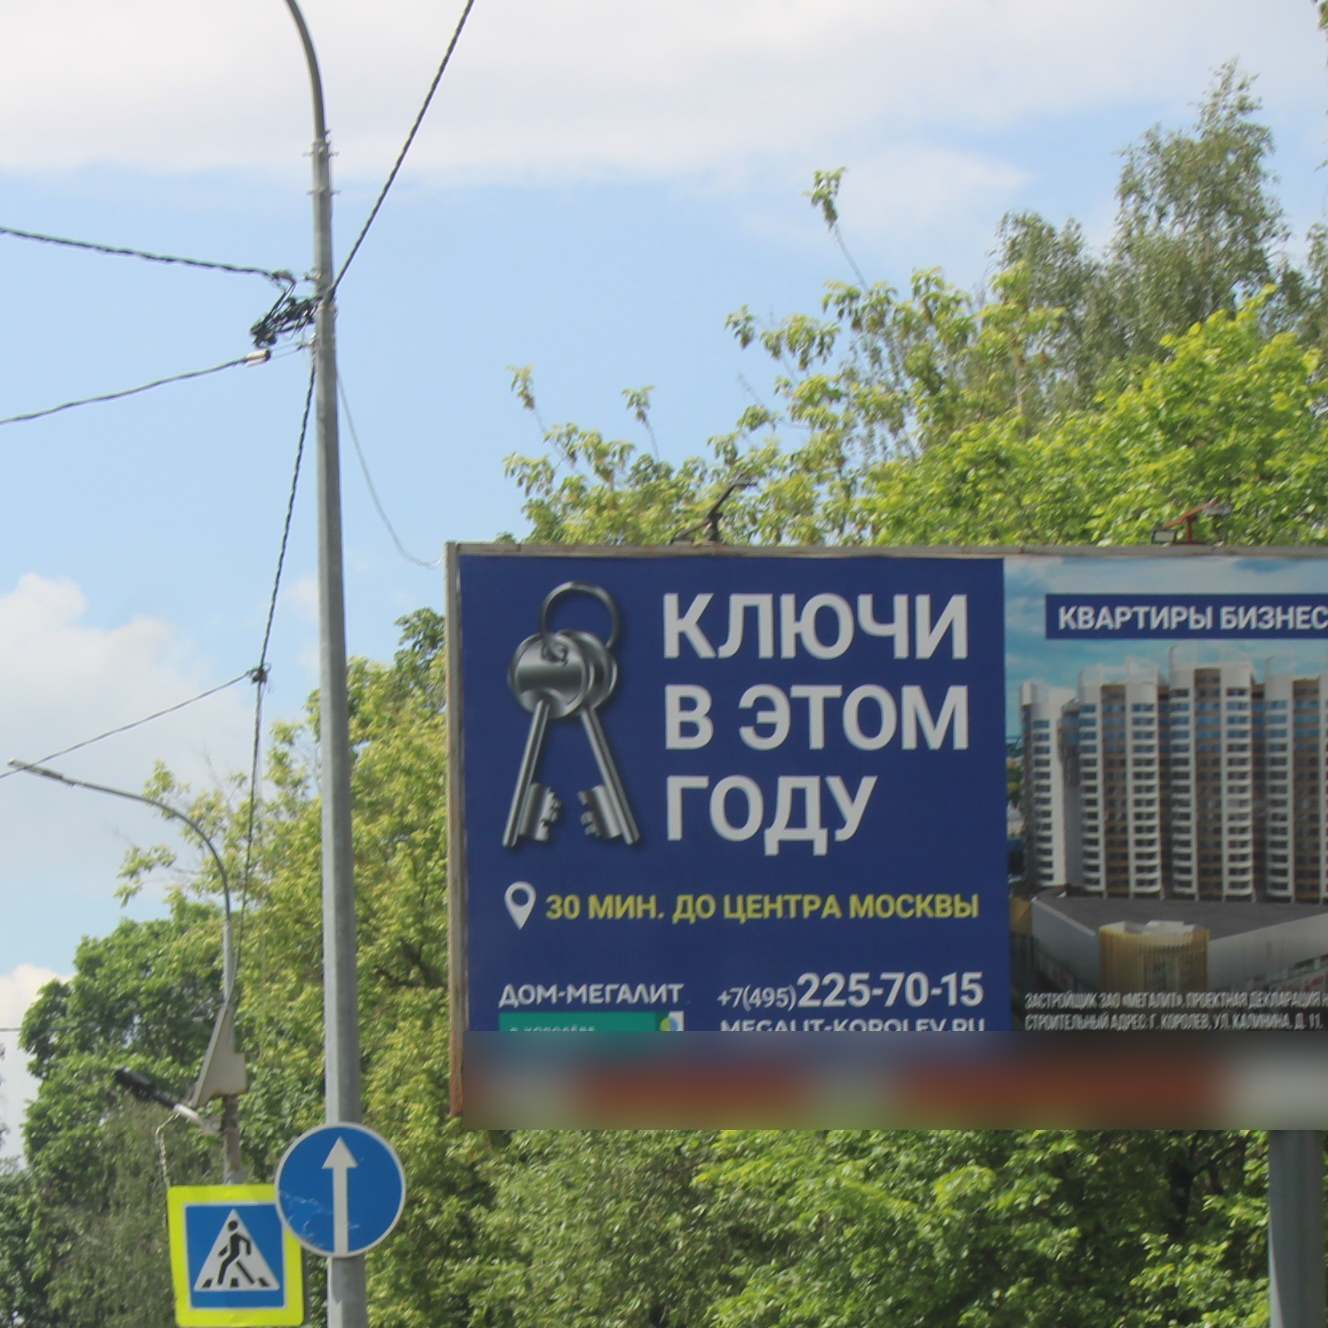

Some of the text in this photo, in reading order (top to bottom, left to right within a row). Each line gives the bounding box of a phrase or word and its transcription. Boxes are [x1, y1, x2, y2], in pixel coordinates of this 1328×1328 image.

[663, 592, 968, 660] КЛЮЧИ
[1058, 606, 1213, 631] КВАРТИРЫ
[664, 683, 969, 751] В ЭТОМ
[666, 774, 878, 856] ГОДУ
[545, 893, 979, 924] 30 МИН. ДО ЦЕНТРА МОСКВЫ
[498, 983, 685, 1009] ДОМ-МЕГАЛИТ
[720, 1017, 985, 1032] MEGALIT-KOROLEVRU
